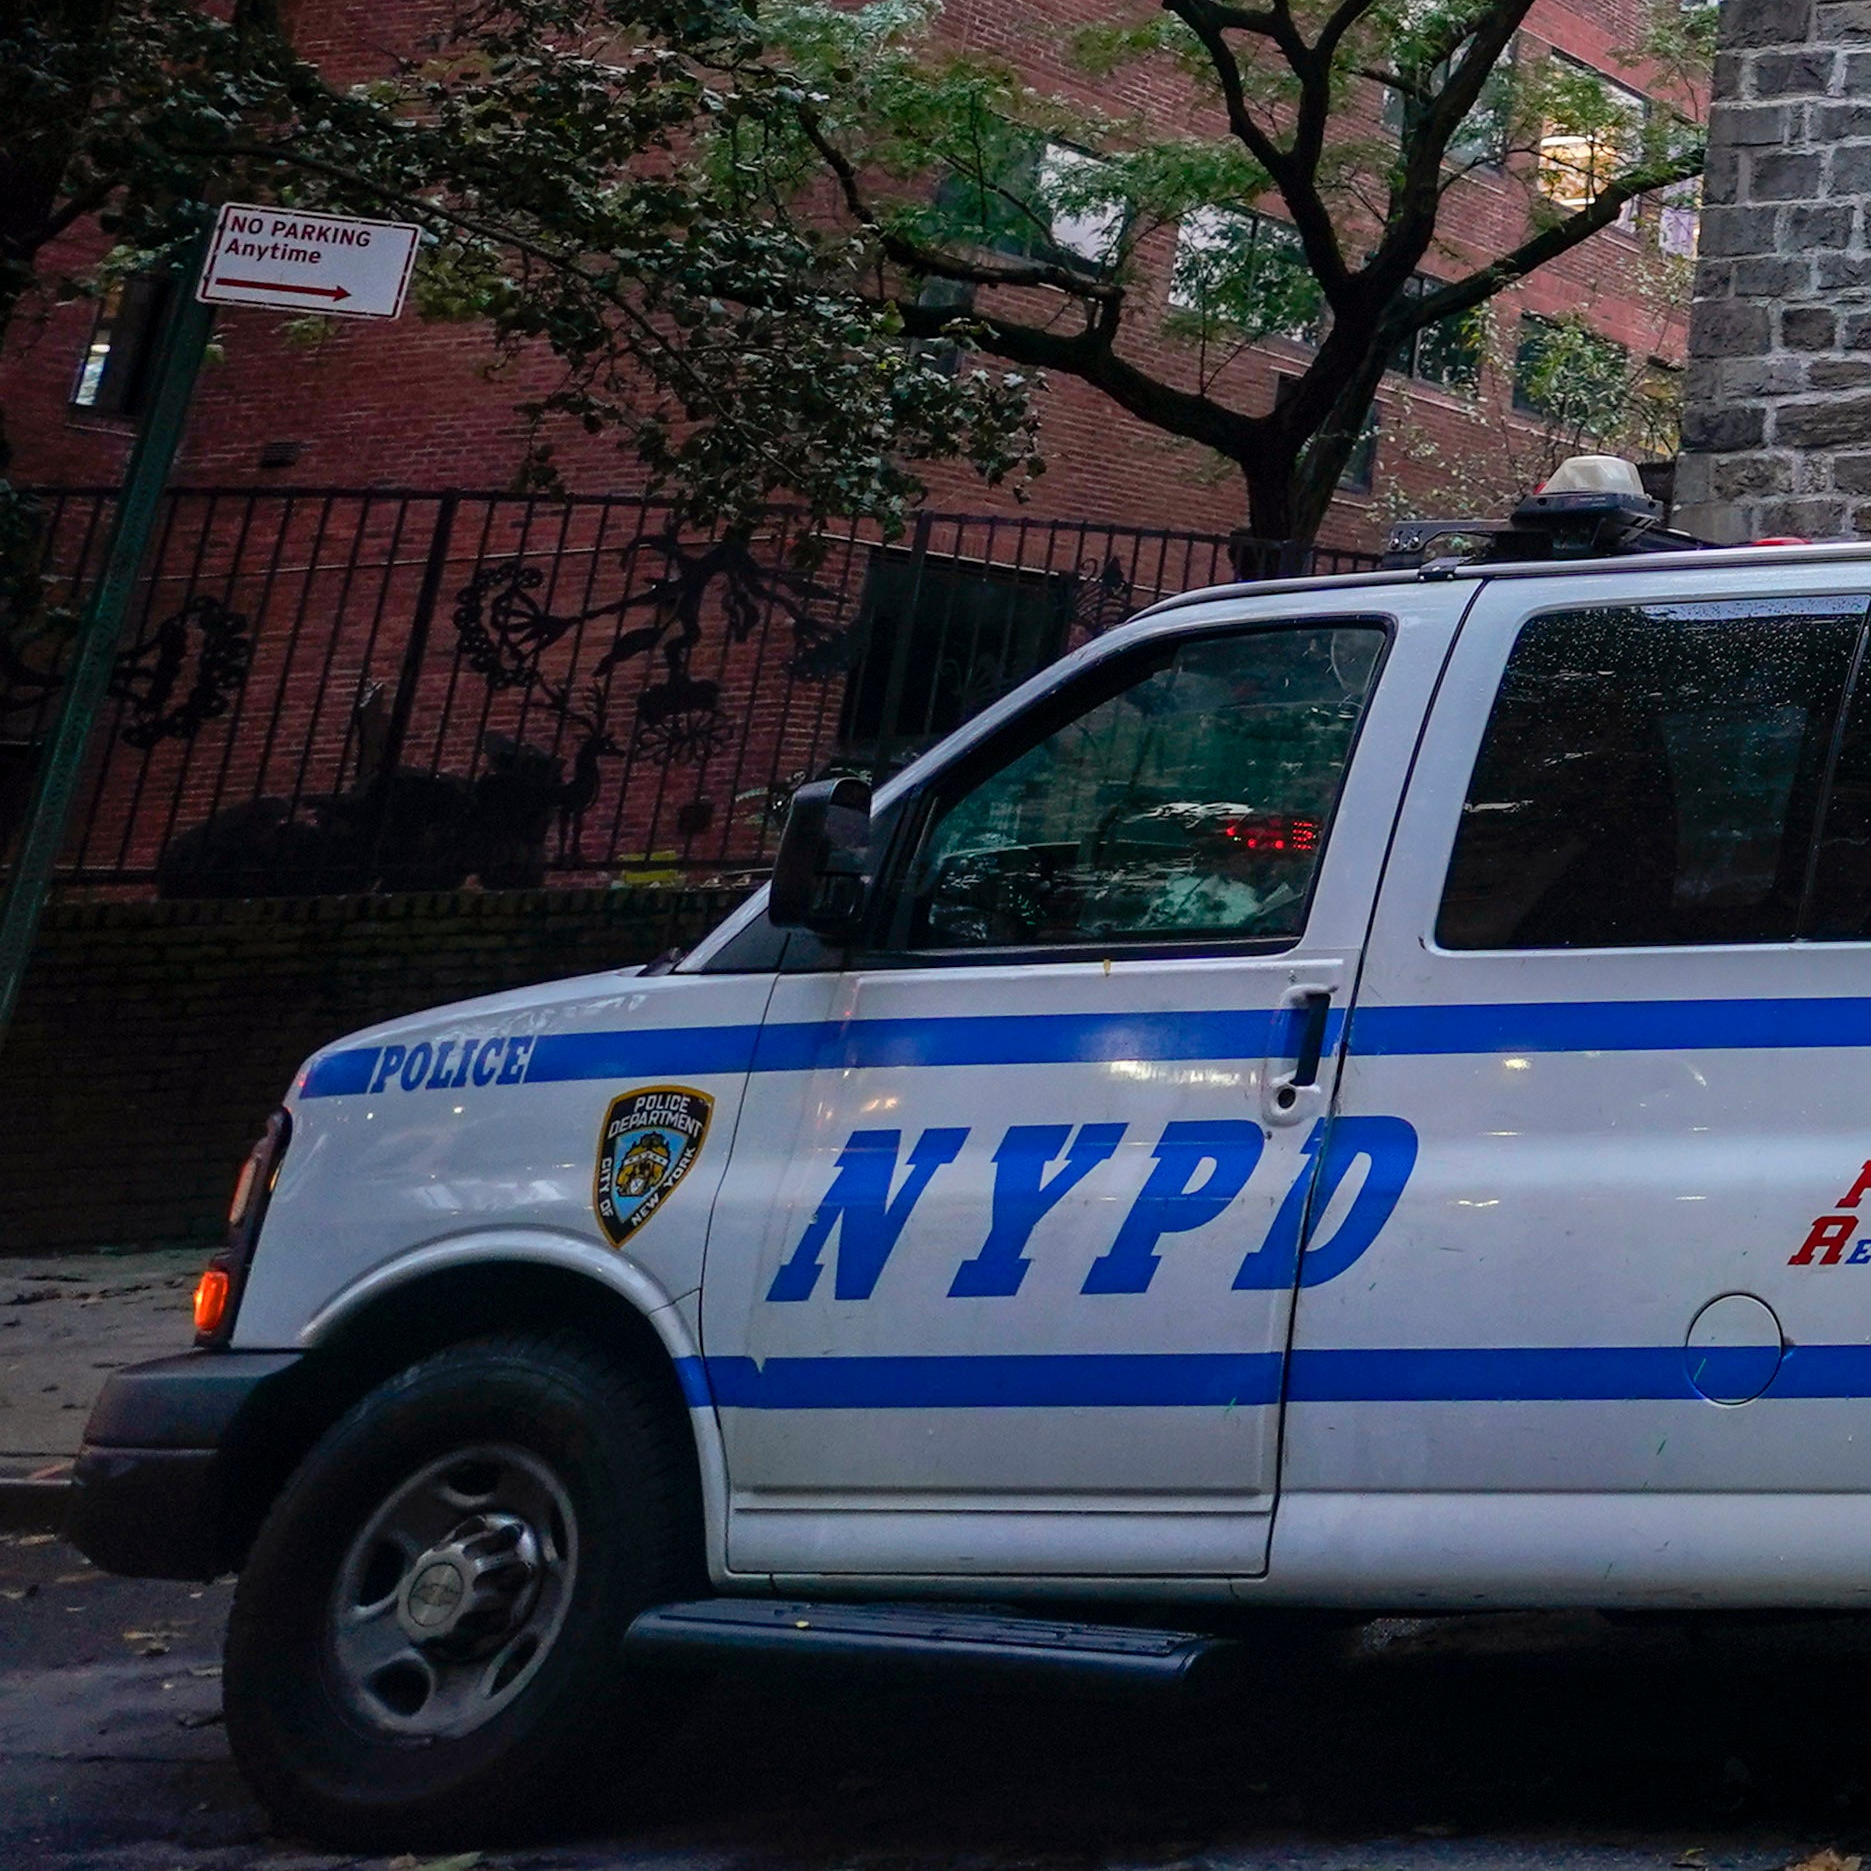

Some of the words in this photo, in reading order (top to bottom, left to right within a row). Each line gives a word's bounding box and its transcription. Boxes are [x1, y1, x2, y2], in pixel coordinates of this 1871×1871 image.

[230, 216, 263, 235] NO
[271, 220, 371, 247] PARKING
[225, 238, 322, 264] Anytime
[369, 1034, 534, 1094] POLICE
[634, 1094, 691, 1113] POLICE
[607, 1110, 703, 1139] DEPARTMENT
[599, 1156, 613, 1195] CITY
[631, 1192, 660, 1227] NEW
[663, 1146, 697, 1189] YORK
[600, 1197, 614, 1217] OF
[765, 1115, 1419, 1301] NYPD
